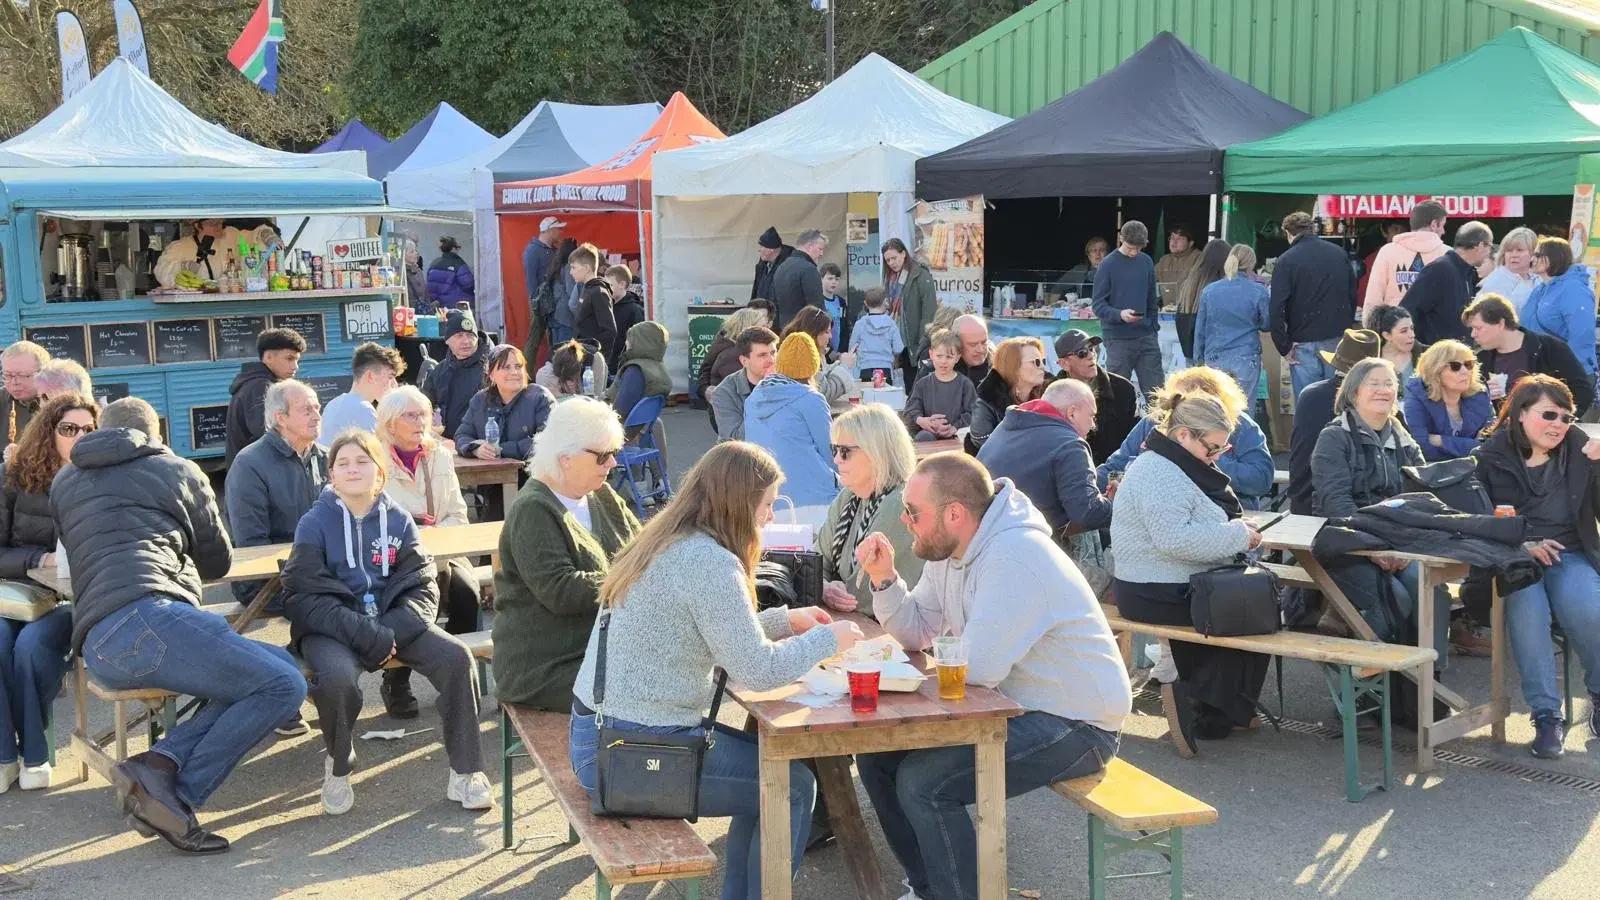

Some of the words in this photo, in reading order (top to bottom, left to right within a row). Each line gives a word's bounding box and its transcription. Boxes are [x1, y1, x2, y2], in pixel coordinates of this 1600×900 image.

[1340, 195, 1416, 215] ITALIAN
[350, 241, 381, 258] COFFEE
[849, 253, 880, 266] Port
[935, 279, 980, 292] urros
[347, 302, 371, 313] Time
[348, 317, 388, 334] Drink
[646, 758, 660, 771] SM
